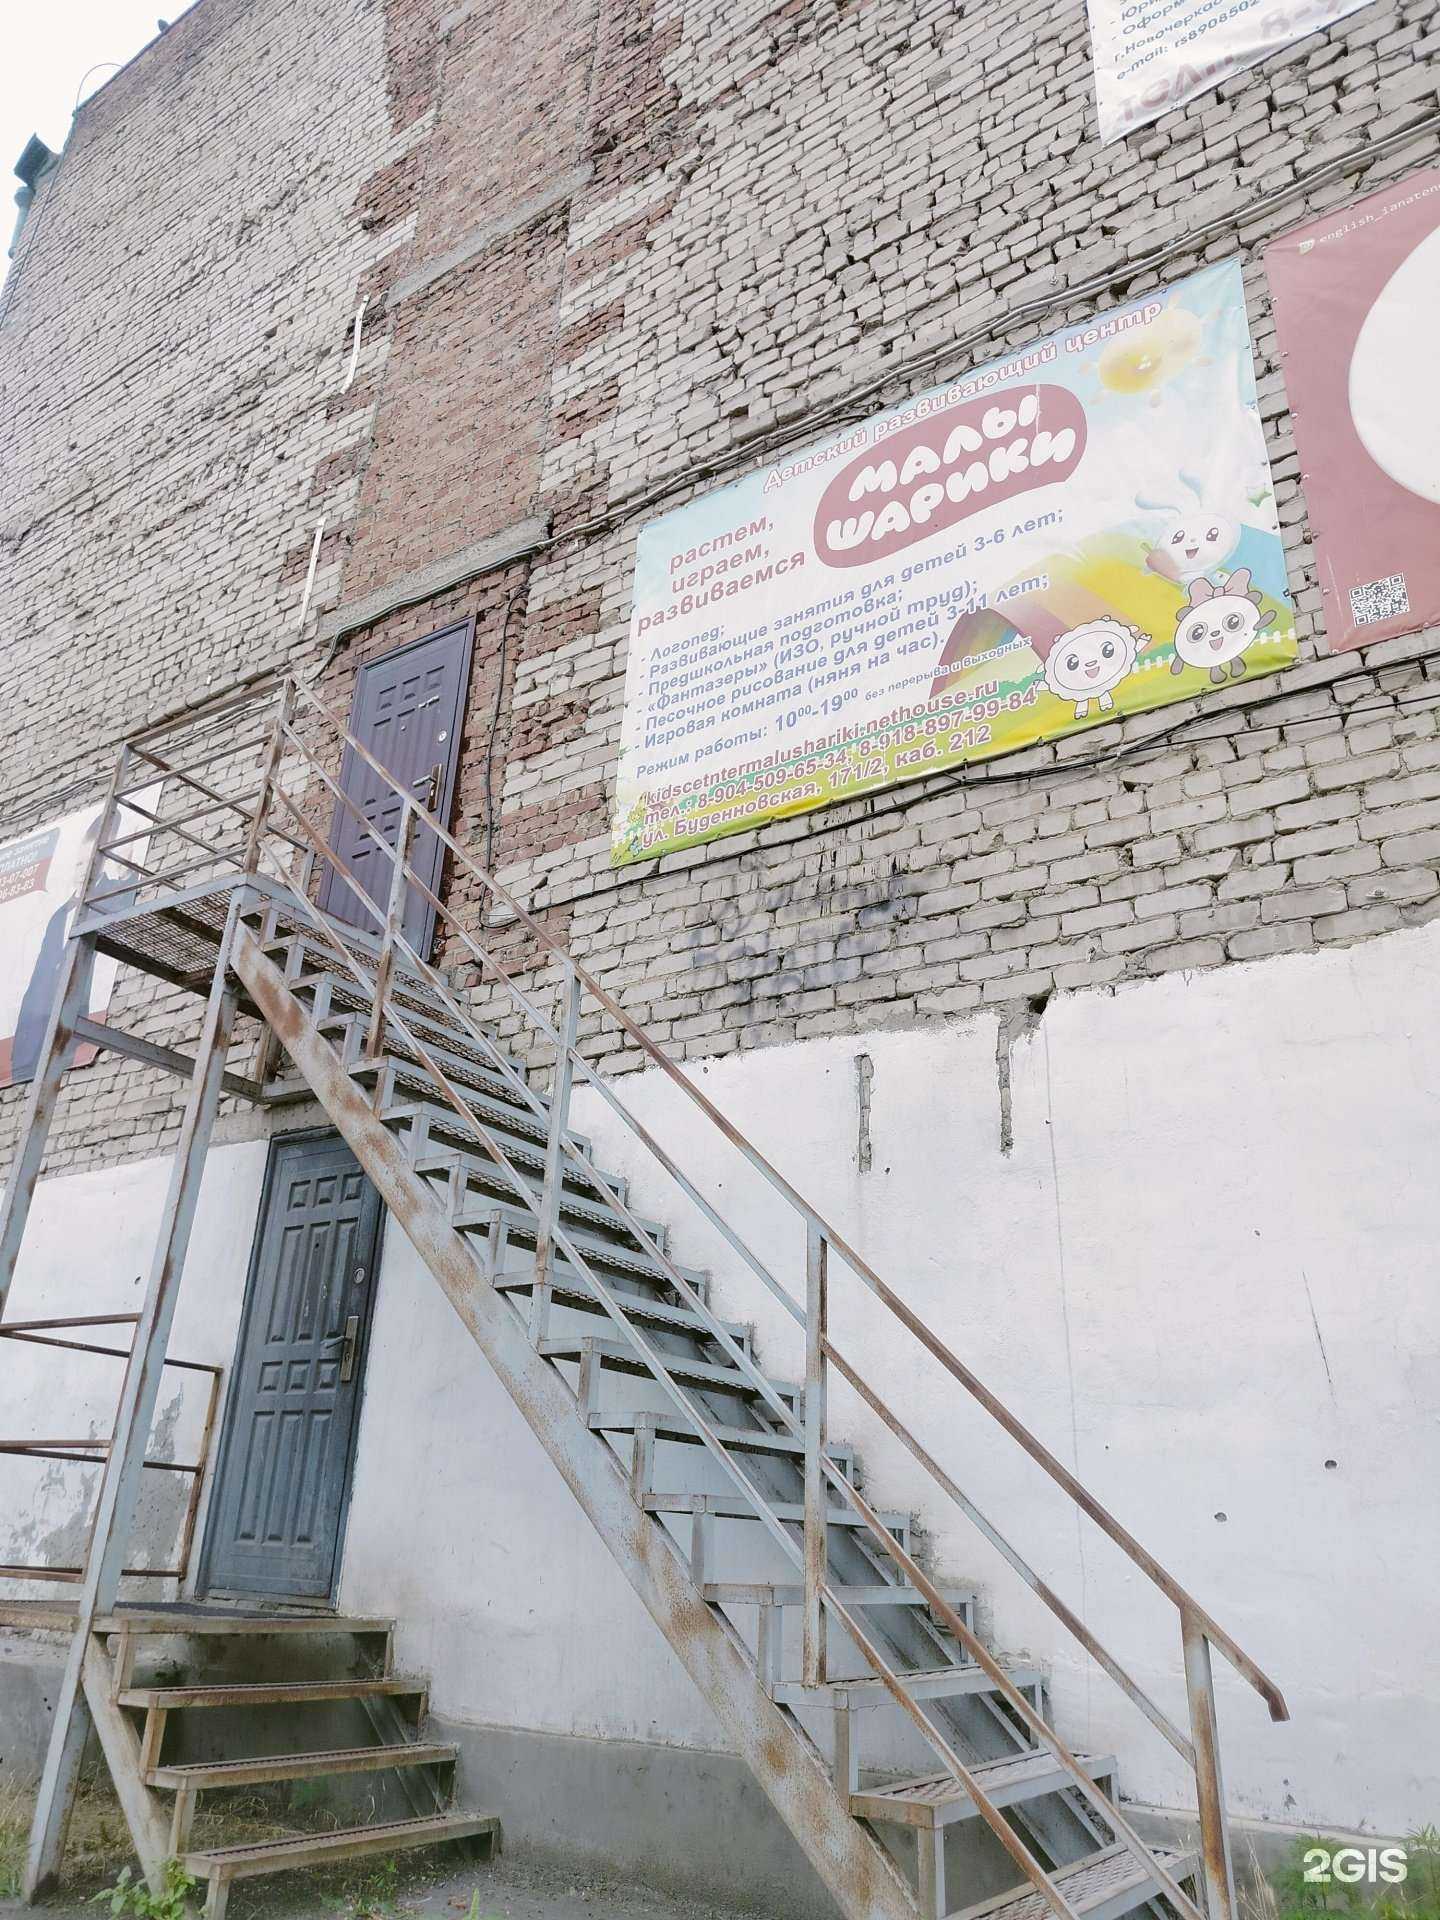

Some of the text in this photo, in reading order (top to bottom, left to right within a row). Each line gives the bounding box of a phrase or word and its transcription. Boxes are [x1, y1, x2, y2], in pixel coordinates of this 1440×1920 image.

[762, 302, 1163, 494] Детский развивающий центр
[848, 394, 1038, 502] МАЛЫ
[669, 515, 775, 575] растем,
[826, 427, 1076, 551] ШАРИКИ
[637, 551, 806, 637] развиваемся
[649, 625, 768, 679] Развивающие
[773, 590, 855, 632] занятия
[860, 574, 896, 599] для
[900, 543, 967, 583] детей
[973, 529, 1006, 552] 3-6
[1011, 509, 1064, 538] лет;
[671, 543, 770, 594] играем,
[644, 715, 716, 751] Игровая
[720, 684, 802, 723] комната
[807, 662, 861, 694] (няня
[867, 652, 891, 669] на
[896, 631, 945, 656] час).
[645, 693, 726, 732] Песочное
[730, 655, 828, 704] рисование
[833, 641, 869, 666] для
[873, 611, 939, 651] детей
[946, 593, 987, 621] 3-11
[996, 574, 1050, 603] лет;
[647, 661, 768, 713] «Фантазеры»
[773, 637, 824, 670] (ИЗО,
[829, 606, 901, 649] ручной
[906, 580, 978, 615] труд);
[648, 640, 775, 697] Предшкольная
[779, 589, 903, 647] подготовка;
[649, 624, 725, 662] Логопед;
[636, 752, 690, 779] Режим
[694, 726, 768, 764] работы:
[864, 687, 886, 702] без
[888, 664, 949, 693] перерыва
[950, 660, 961, 672] и
[960, 635, 1033, 668] выходных
[858, 687, 1038, 757] 8-918-897-99-84
[642, 725, 991, 848] ул. Буденновская, 171/2, каб. 212
